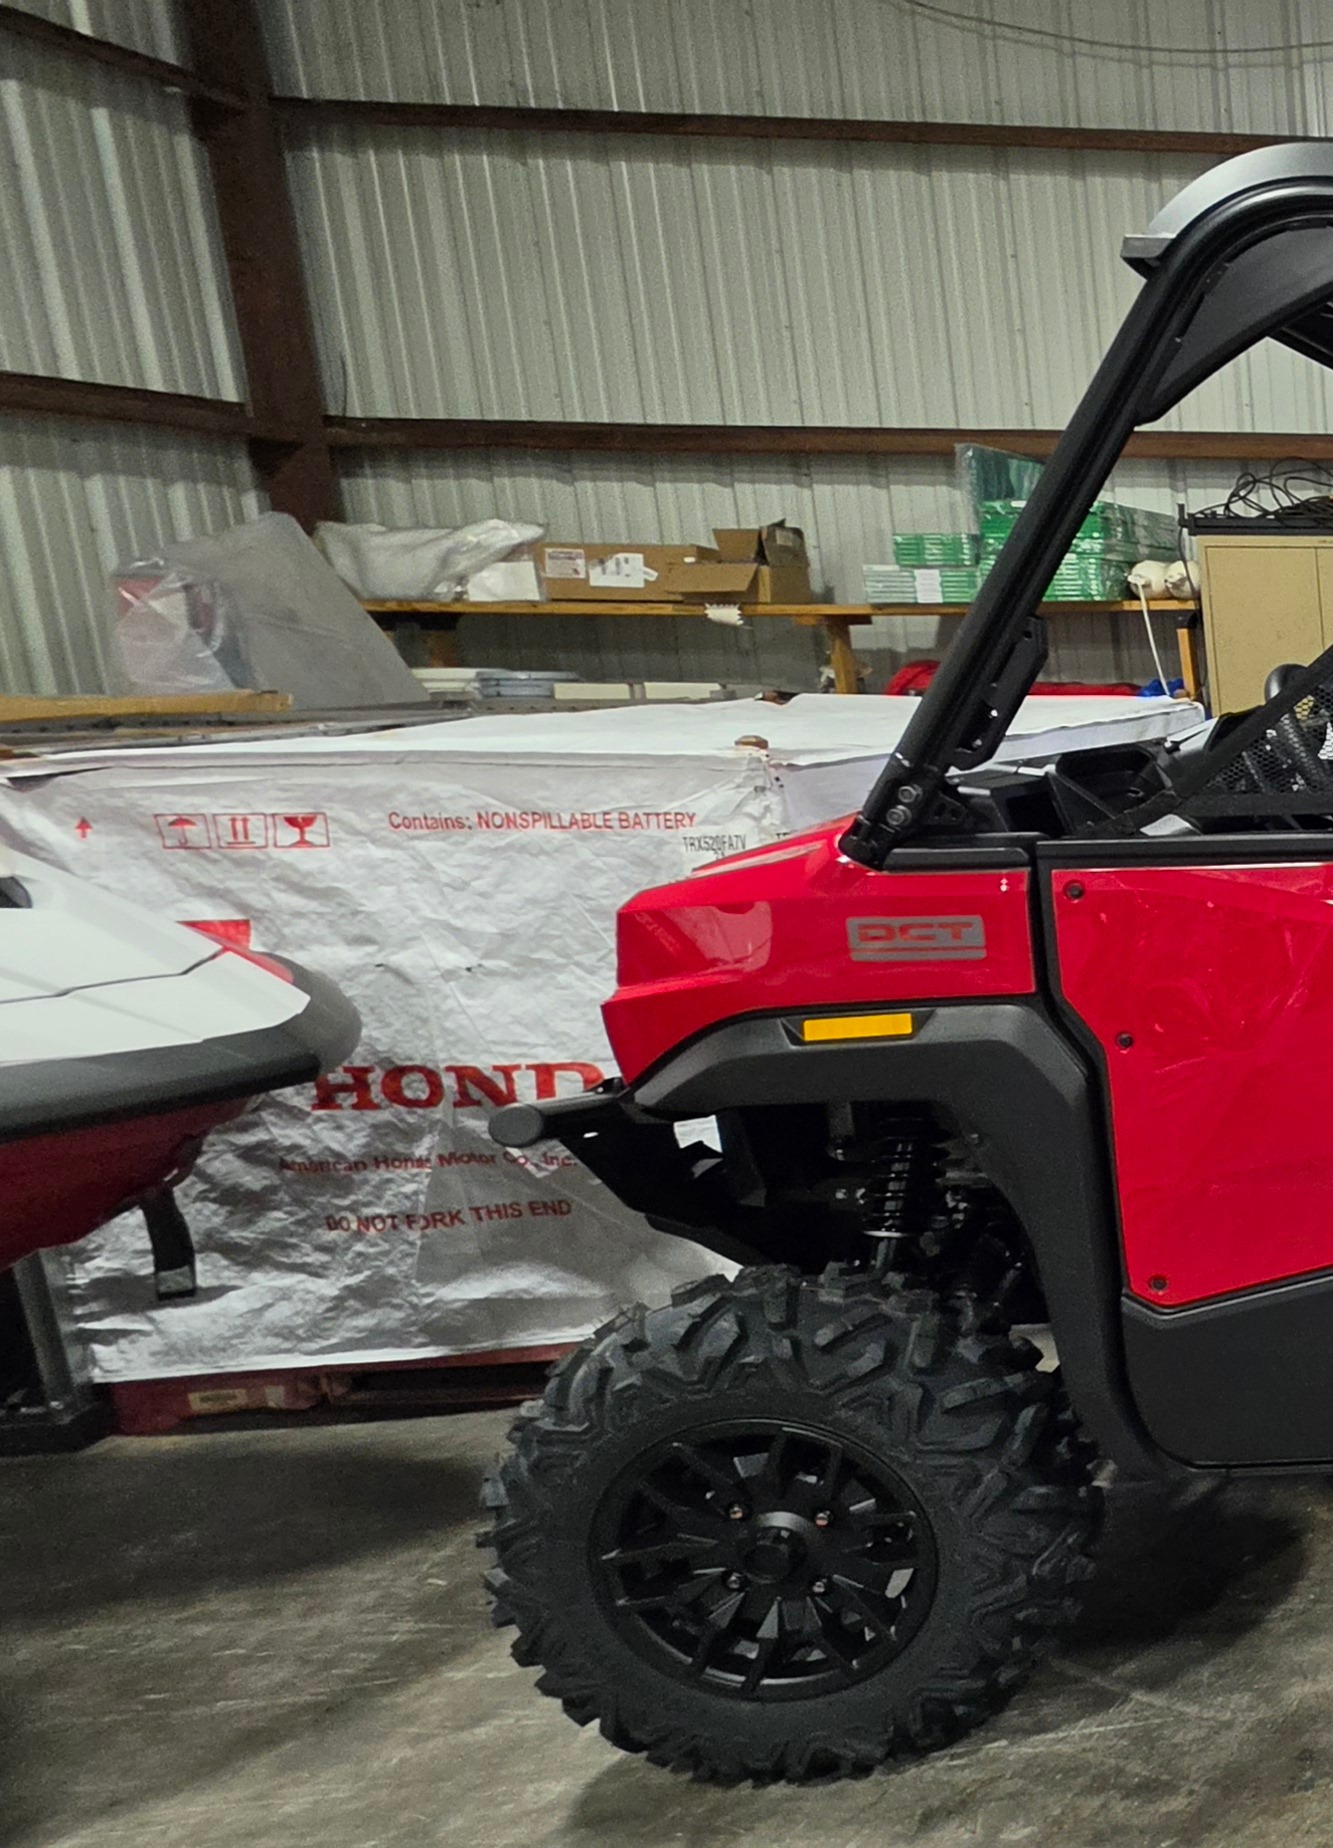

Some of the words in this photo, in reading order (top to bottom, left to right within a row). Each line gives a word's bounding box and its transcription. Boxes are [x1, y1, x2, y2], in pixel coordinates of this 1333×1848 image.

[387, 812, 473, 832] Contains:
[477, 811, 614, 831] NONSPILLABLE
[618, 811, 697, 830] BATTERY
[857, 922, 974, 942] DCT
[311, 1061, 607, 1111] HOND
[437, 1151, 497, 1167] Motor
[324, 1213, 351, 1232] DO
[356, 1213, 400, 1232] NOT
[405, 1210, 466, 1231] FORK
[469, 1202, 524, 1224] THIS
[528, 1199, 573, 1217] END
